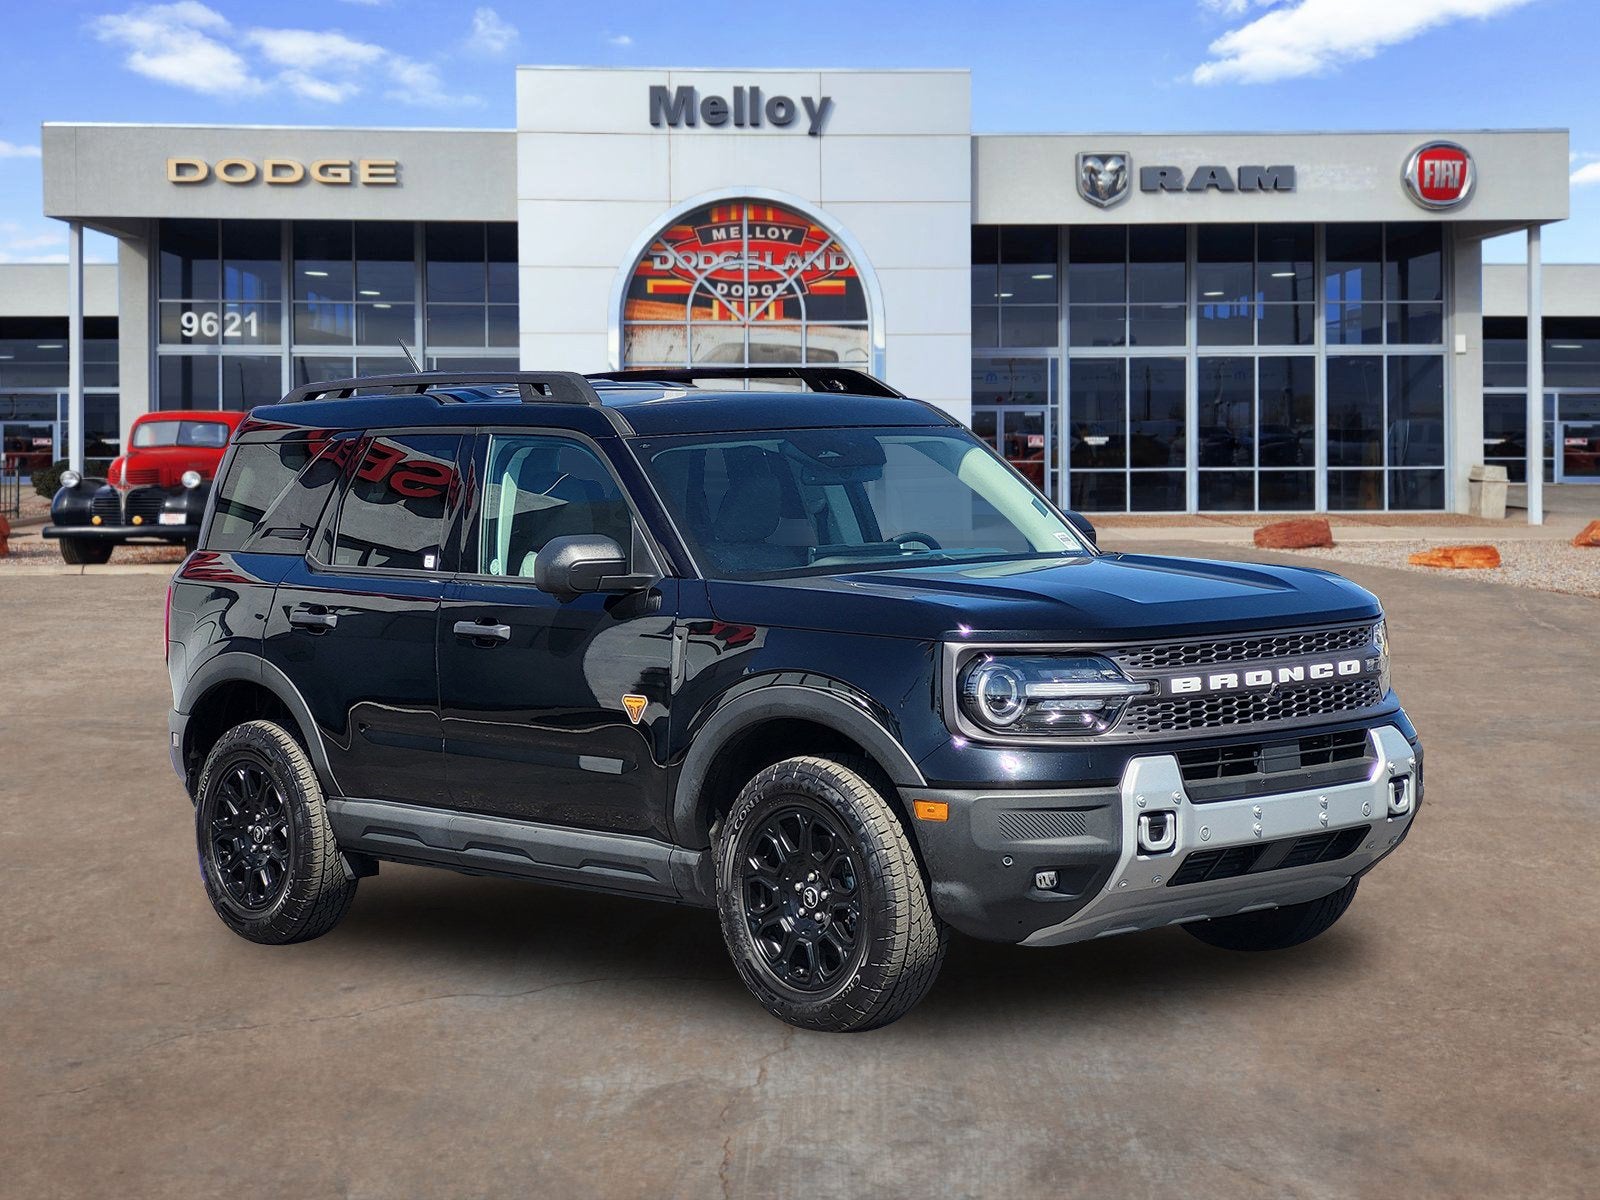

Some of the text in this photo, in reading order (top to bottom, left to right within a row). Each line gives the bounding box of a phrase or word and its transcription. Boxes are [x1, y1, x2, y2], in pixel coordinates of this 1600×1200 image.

[649, 85, 832, 136] Melloy
[166, 158, 398, 184] DODGE
[1140, 164, 1296, 192] RAM
[1423, 160, 1463, 189] FIAT
[181, 311, 258, 337] 9621
[1171, 659, 1361, 694] BRONCO
